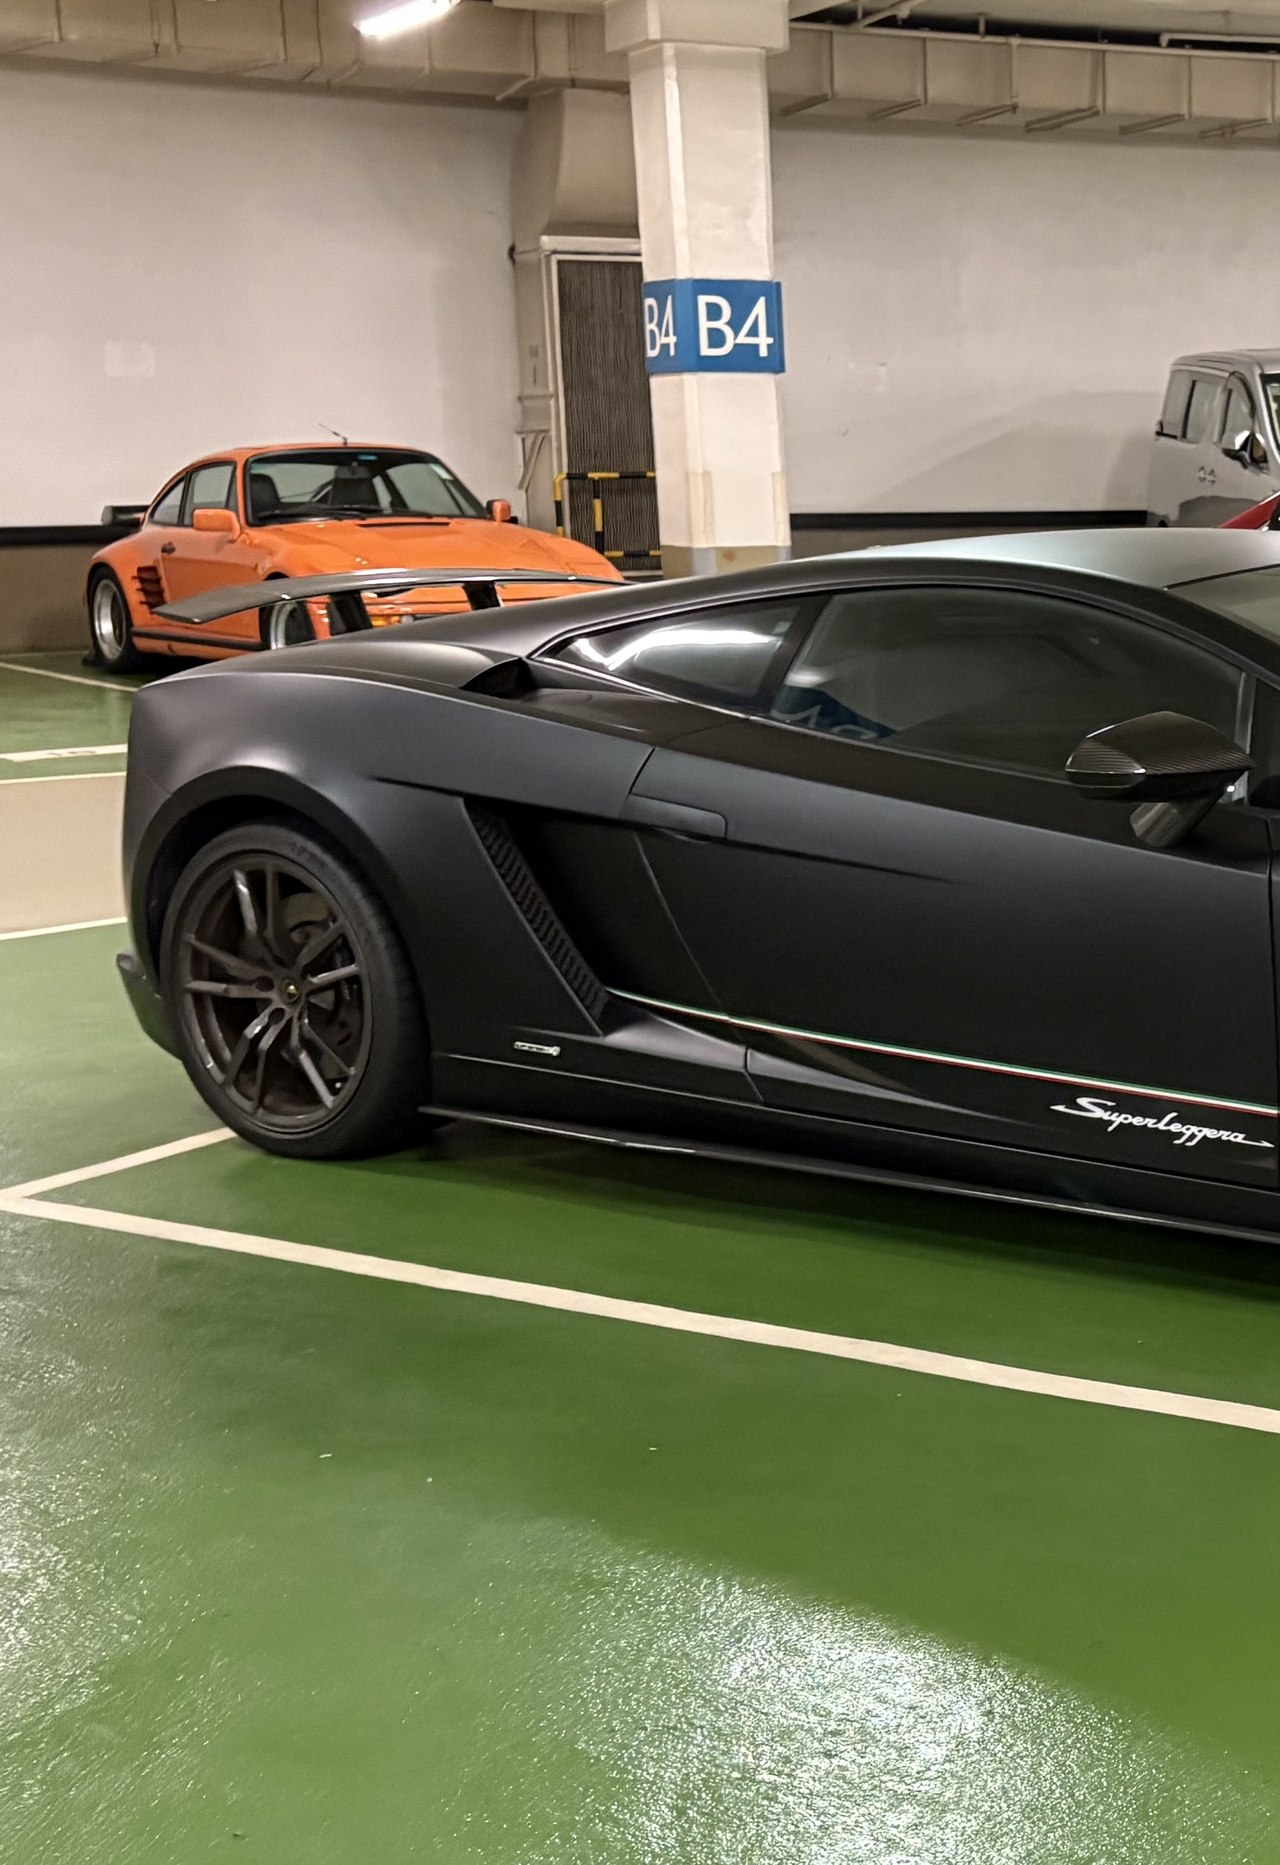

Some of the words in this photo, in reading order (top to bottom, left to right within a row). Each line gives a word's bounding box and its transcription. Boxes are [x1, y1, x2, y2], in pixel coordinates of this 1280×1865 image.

[644, 295, 677, 358] B4
[697, 294, 774, 357] B4
[1050, 1097, 1275, 1147] Superleggera
